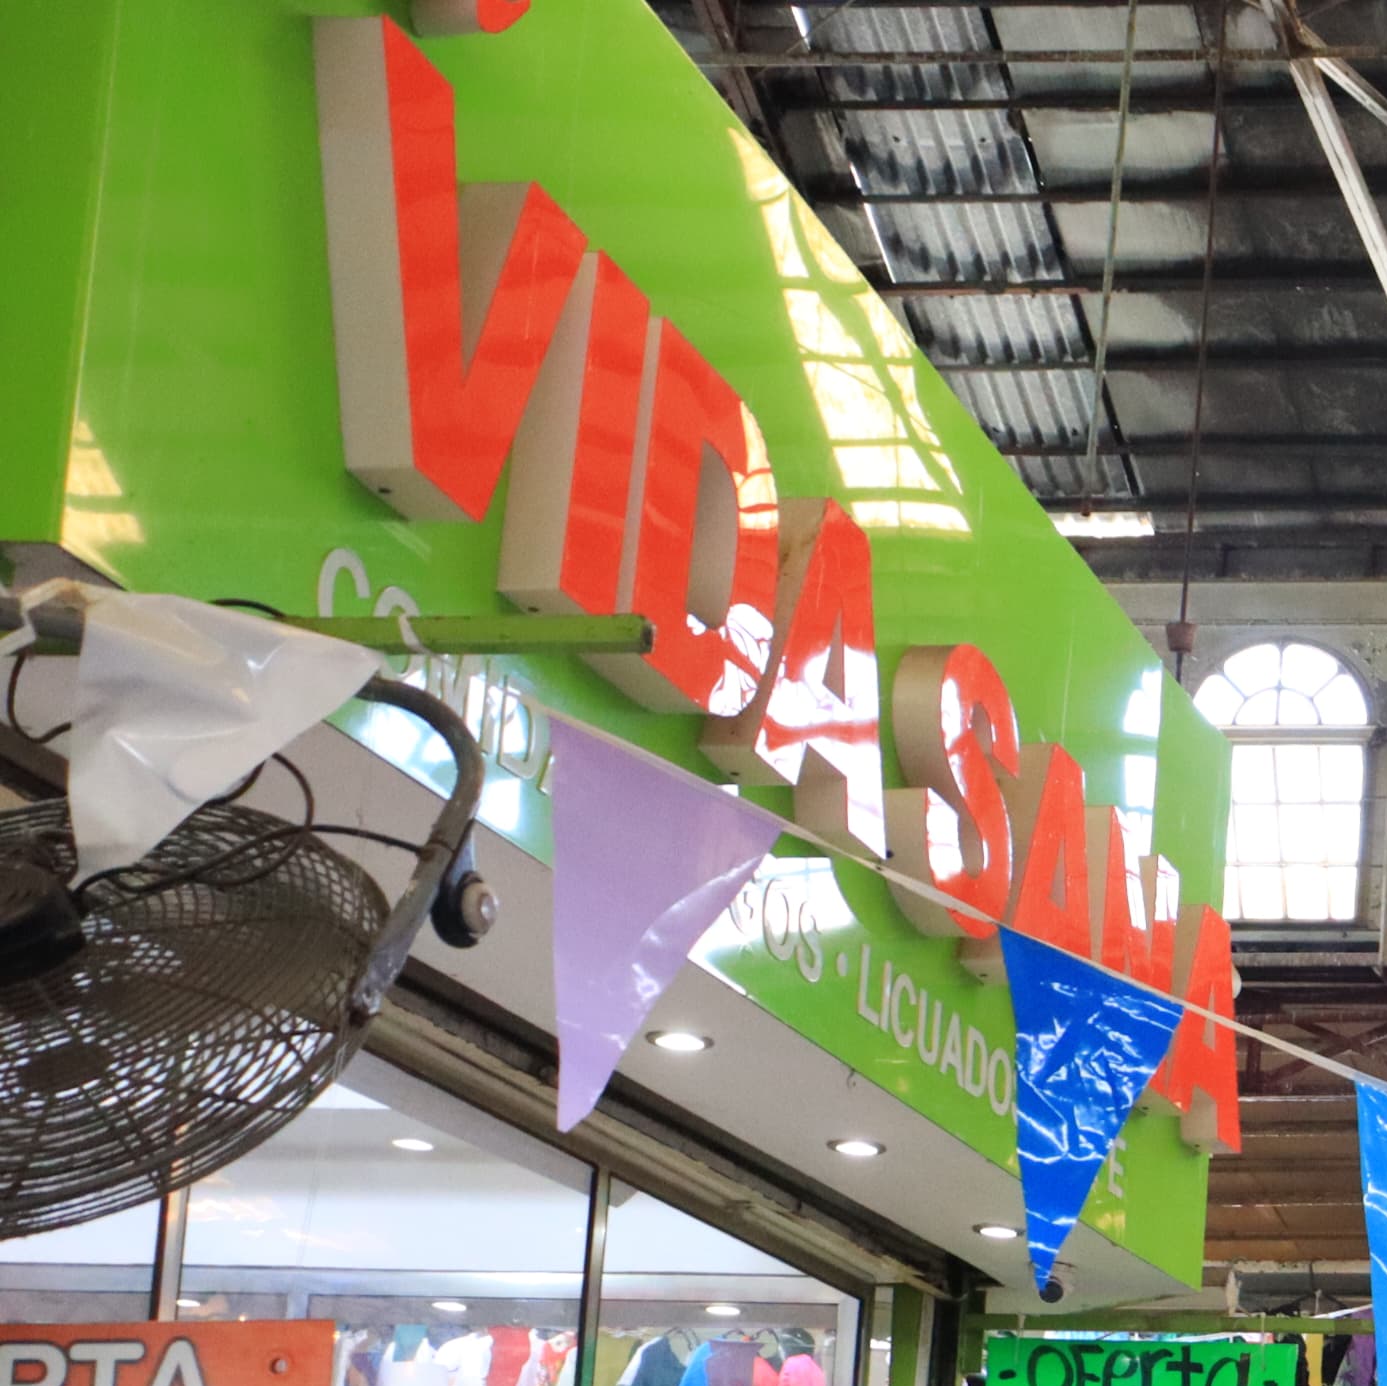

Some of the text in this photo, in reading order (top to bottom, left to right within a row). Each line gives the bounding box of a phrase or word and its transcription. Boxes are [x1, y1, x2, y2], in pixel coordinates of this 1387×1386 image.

[350, 13, 1241, 1153] VIDA SANA
[856, 943, 1019, 1127] LICUADO
